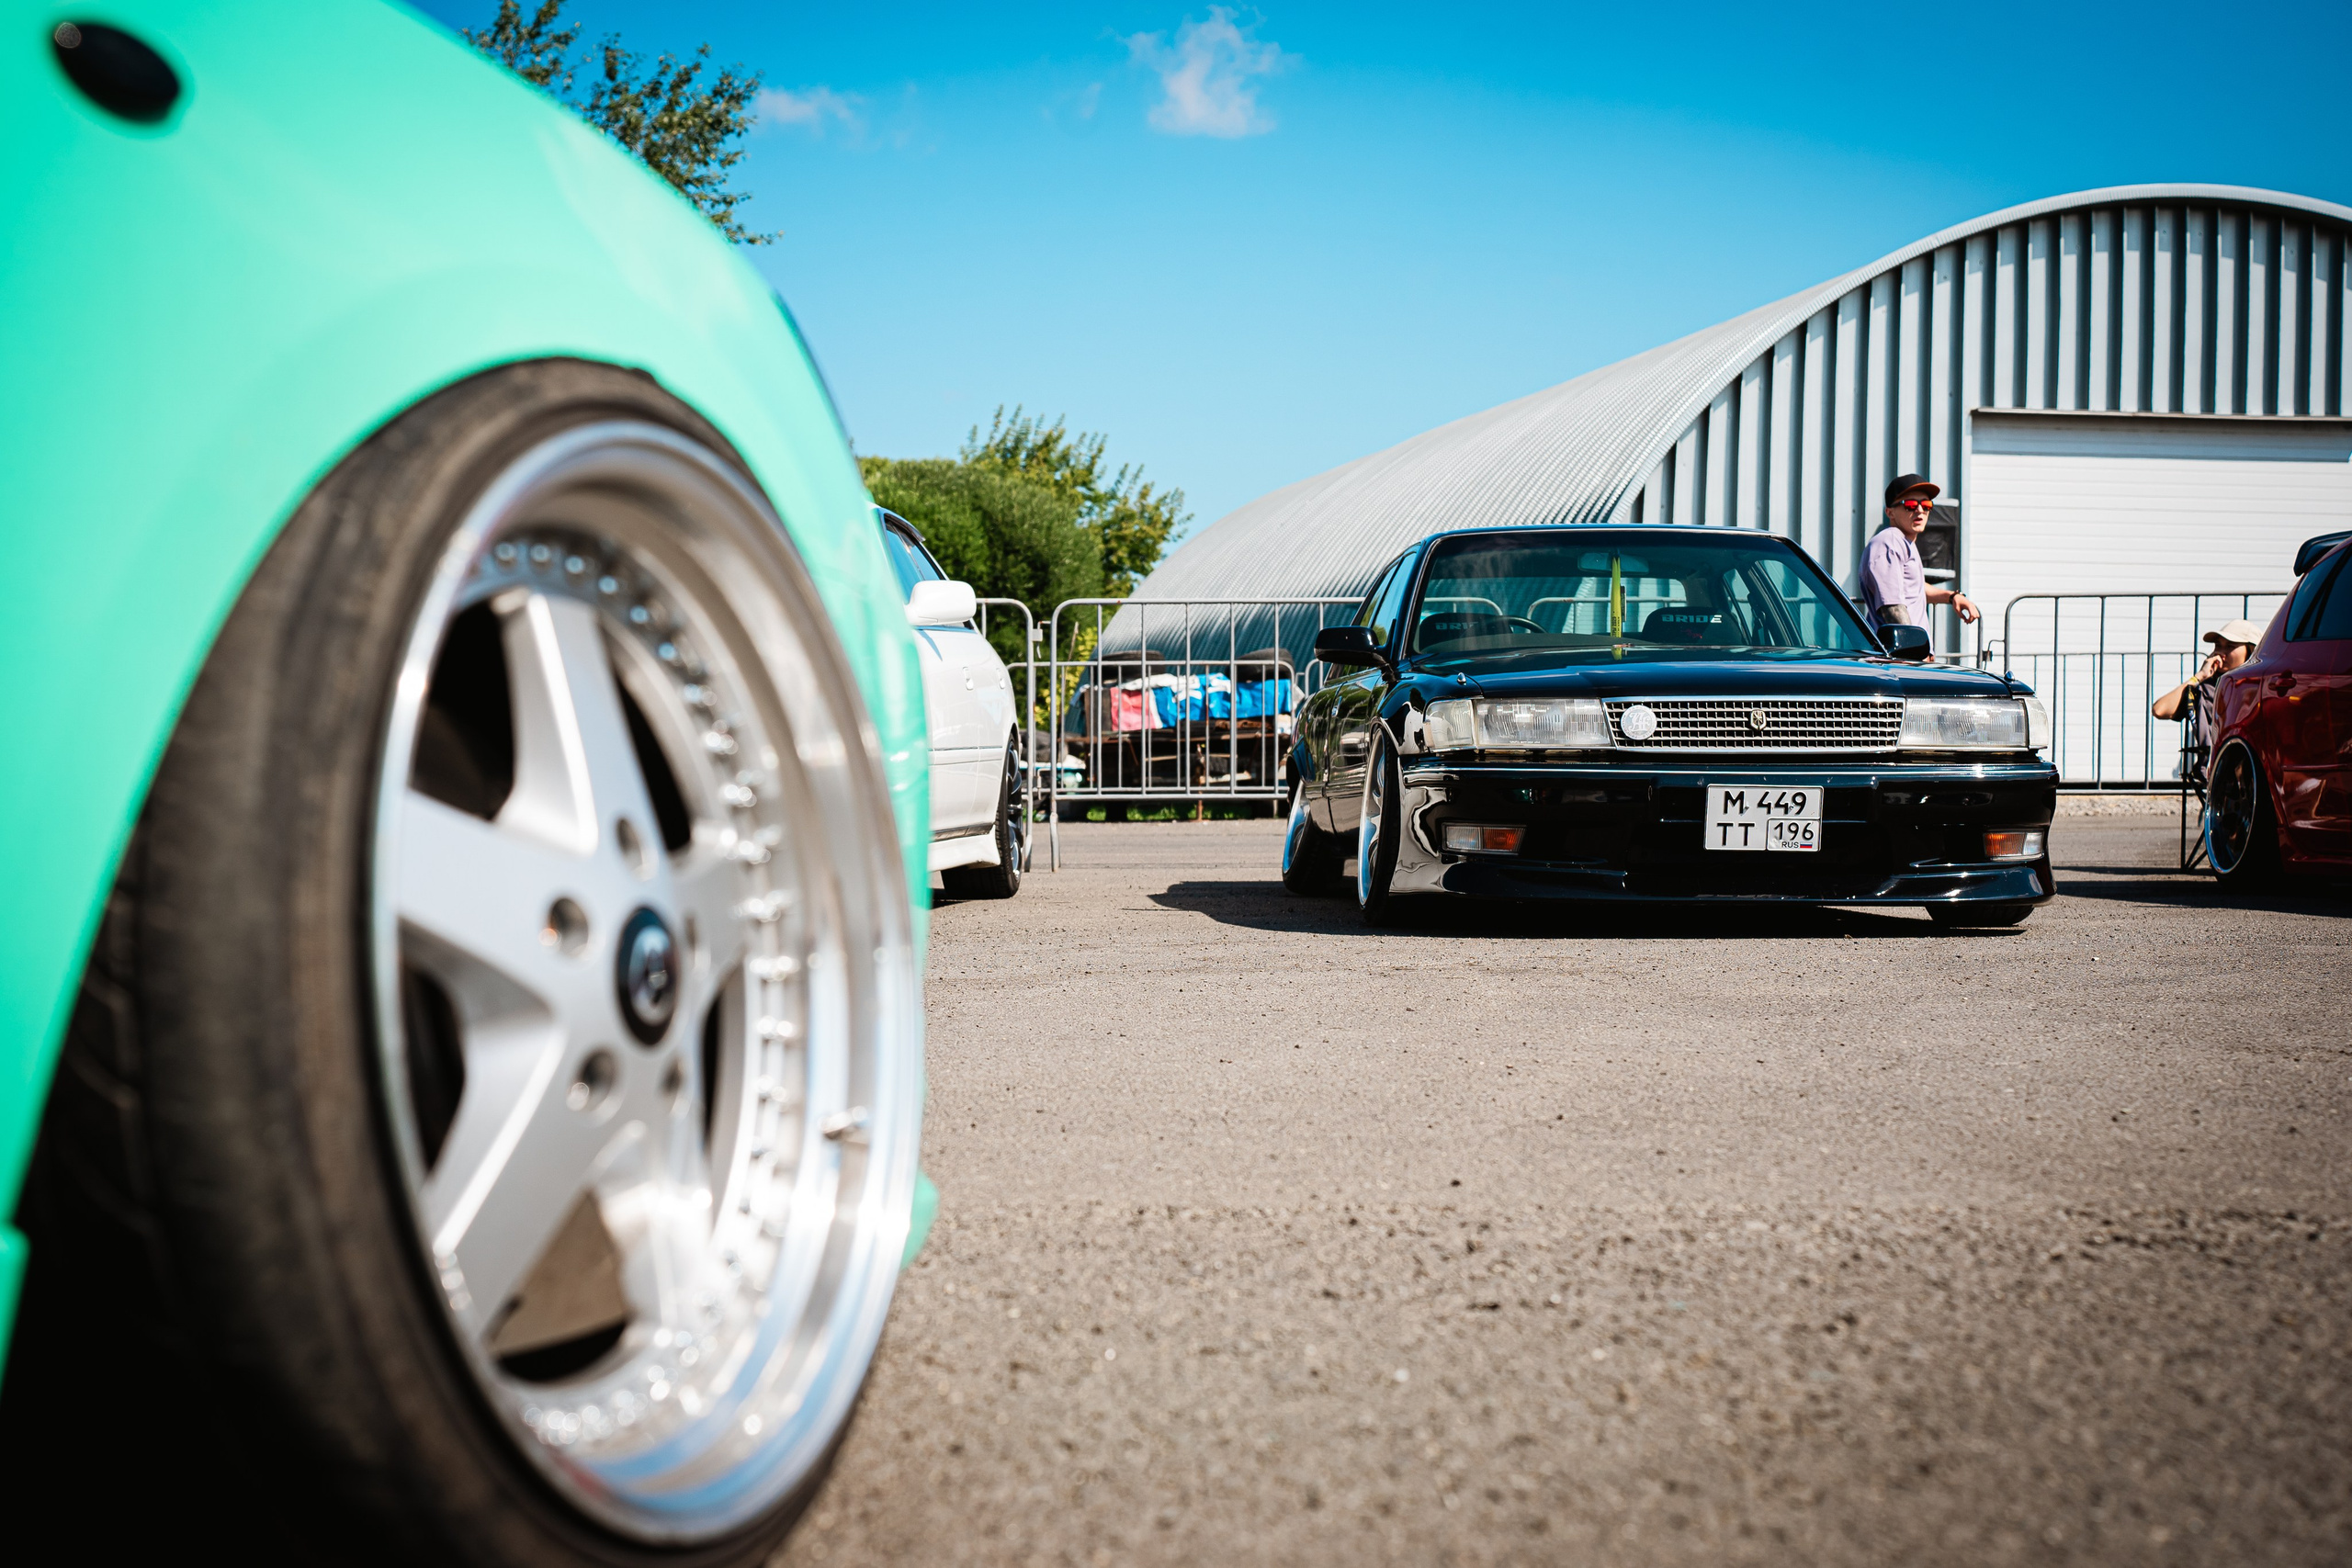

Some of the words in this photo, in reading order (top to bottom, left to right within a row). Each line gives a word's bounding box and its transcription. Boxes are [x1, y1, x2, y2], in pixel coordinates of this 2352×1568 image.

[1661, 614, 1722, 624] BRIDE
[1723, 790, 1745, 815] M
[1757, 791, 1807, 816] 449
[1716, 822, 1755, 847] TT
[1773, 821, 1815, 841] 196
[1781, 840, 1800, 849] RUS
